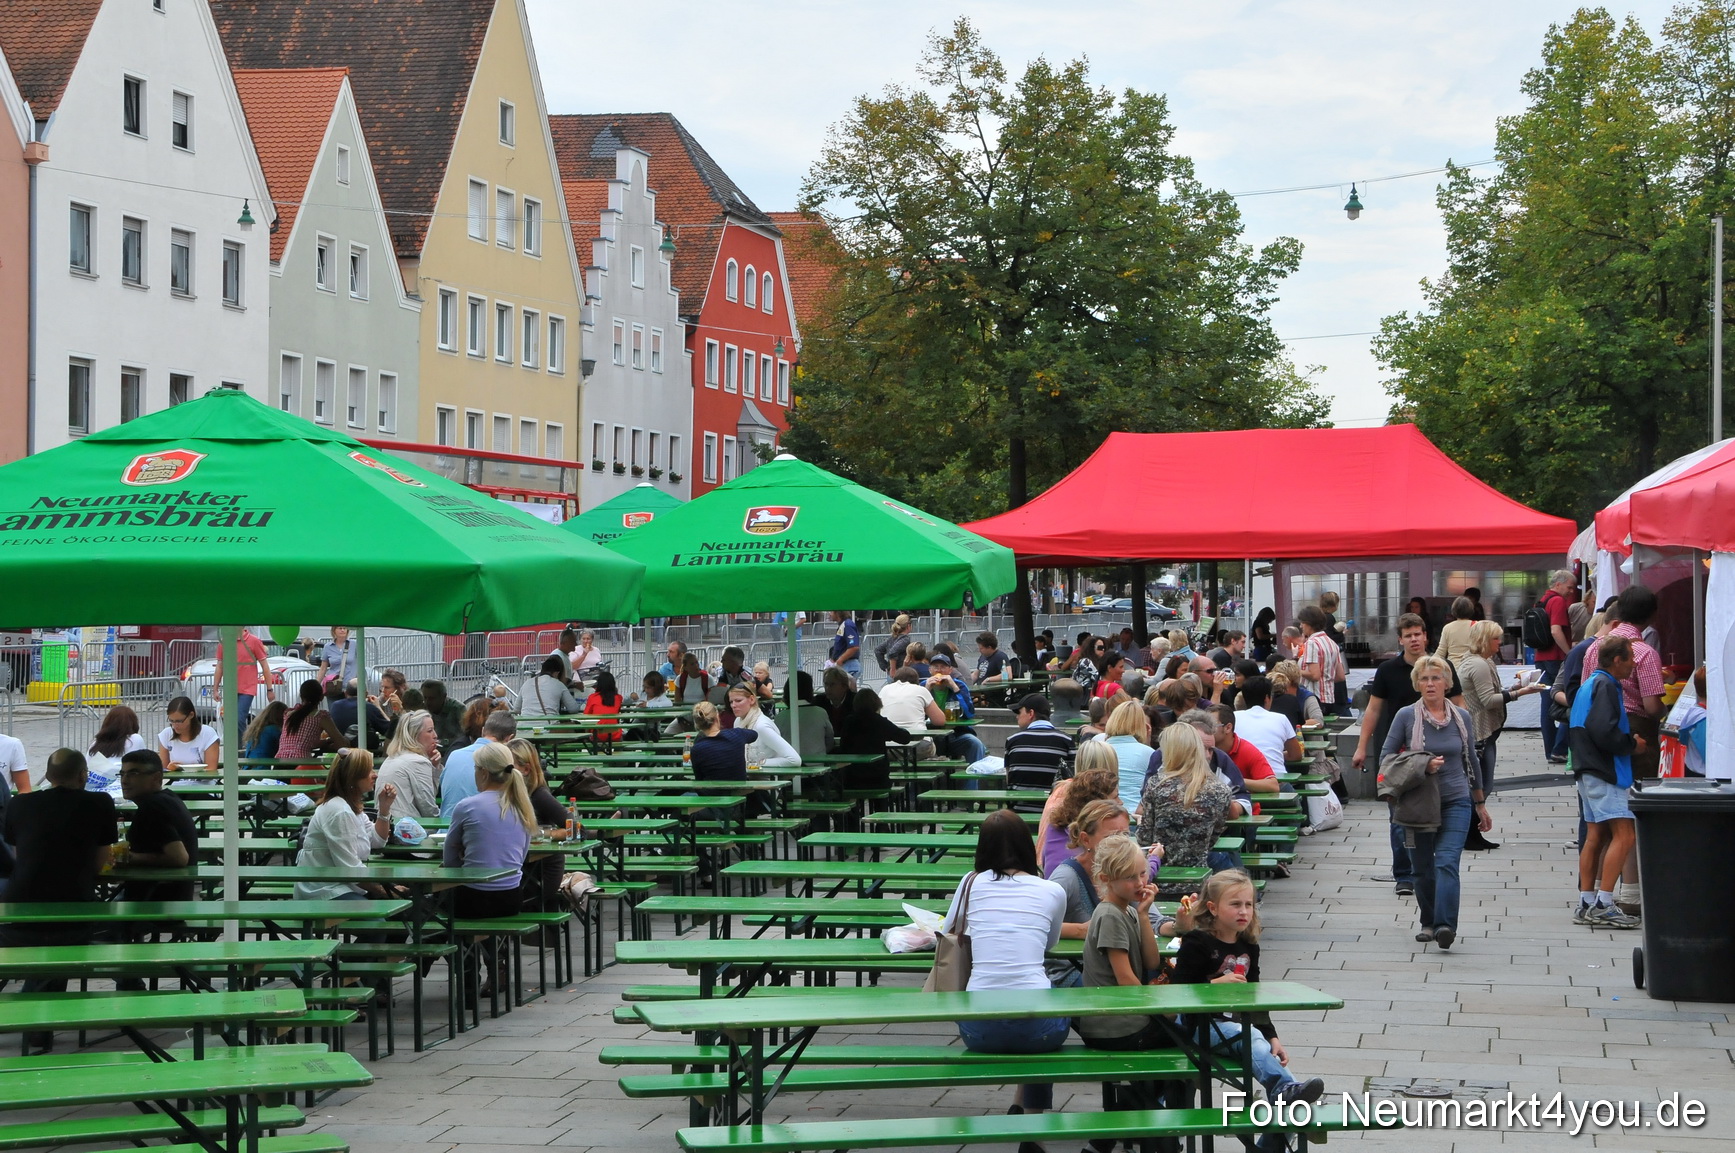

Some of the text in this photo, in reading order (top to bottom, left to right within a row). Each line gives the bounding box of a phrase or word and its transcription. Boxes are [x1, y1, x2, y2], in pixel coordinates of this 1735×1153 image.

[29, 490, 248, 509] Neumarkter
[0, 505, 274, 531] ammsbräu
[2, 537, 57, 546] FEINE
[63, 535, 209, 544] ÖKOLOGISCHE
[700, 539, 826, 551] Neumarkter
[671, 550, 844, 567] Lammsbräu
